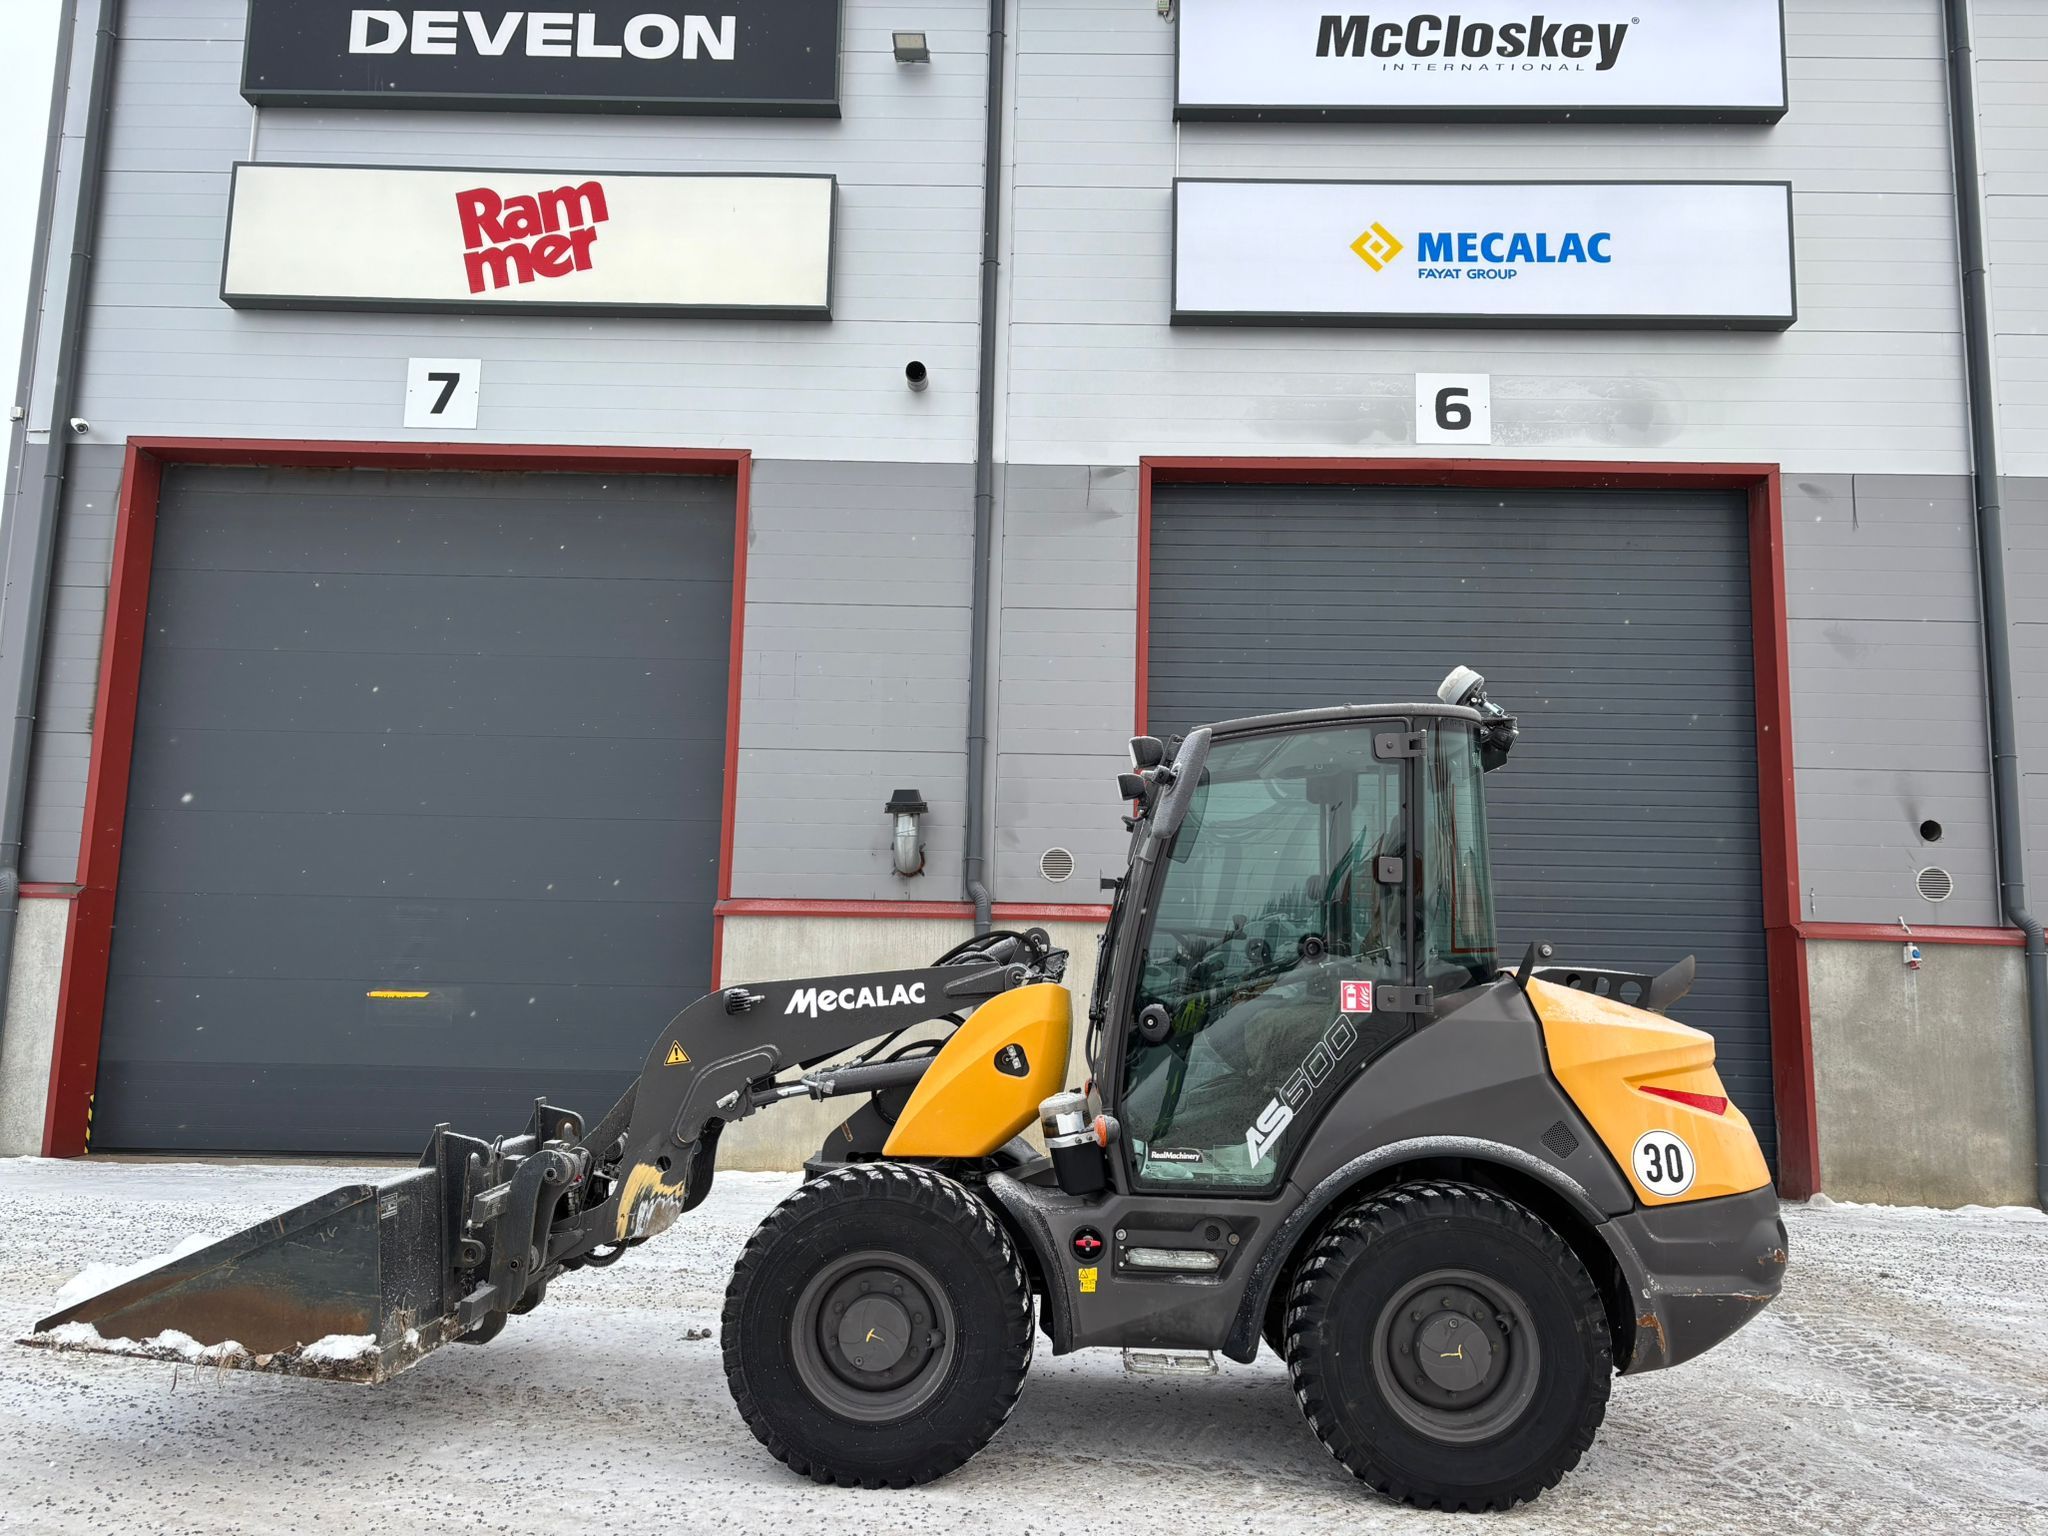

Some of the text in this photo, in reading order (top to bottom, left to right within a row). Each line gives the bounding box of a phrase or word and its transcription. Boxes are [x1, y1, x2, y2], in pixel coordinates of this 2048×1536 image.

[348, 10, 736, 60] DEVELON
[1382, 63, 1584, 71] INTERNATIONAL
[1417, 232, 1612, 264] MECALAC
[1418, 268, 1517, 280] FAYAT GROUP
[427, 372, 460, 414] 7
[1435, 387, 1472, 431] 6
[1151, 1151, 1201, 1162] RealMachinery
[1643, 1143, 1684, 1183] 30
